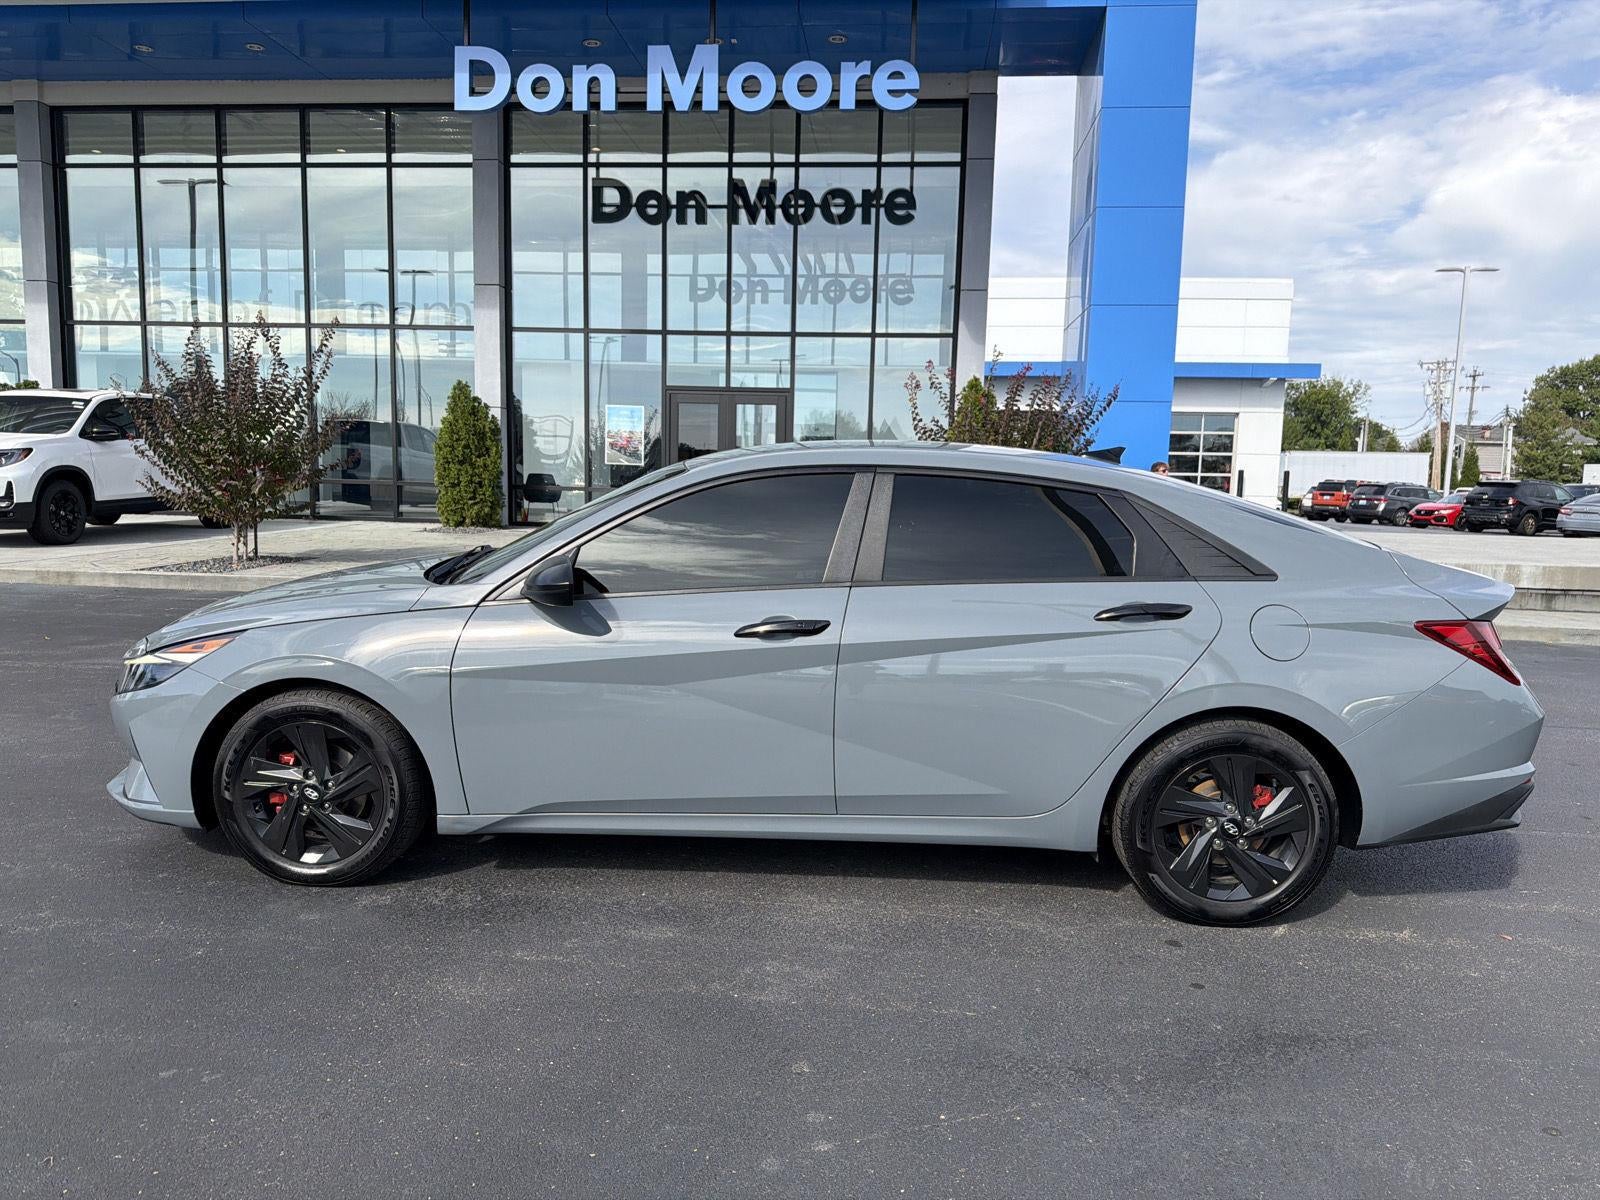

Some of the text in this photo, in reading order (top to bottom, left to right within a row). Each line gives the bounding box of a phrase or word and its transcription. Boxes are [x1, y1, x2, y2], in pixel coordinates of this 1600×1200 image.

[453, 44, 920, 113] Don Moore
[591, 177, 918, 226] Don Moore
[689, 274, 915, 306] Don Moore
[384, 765, 396, 809] EDGE
[1308, 783, 1325, 829] EDGE
